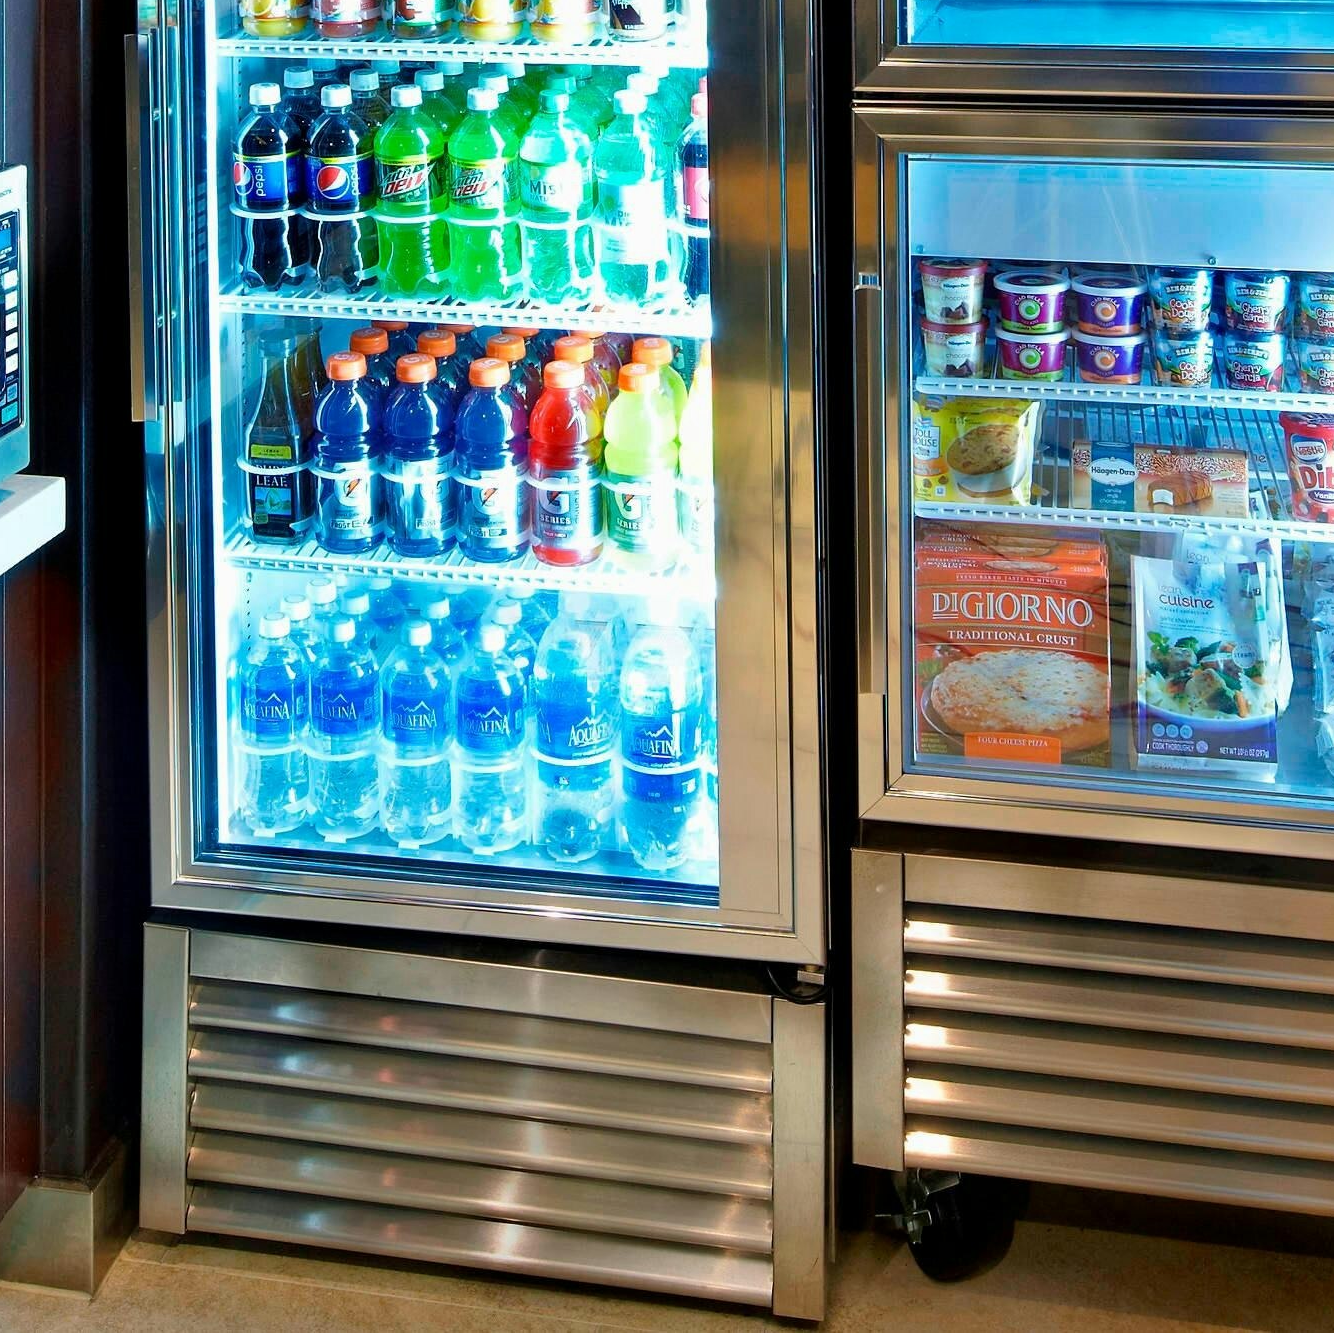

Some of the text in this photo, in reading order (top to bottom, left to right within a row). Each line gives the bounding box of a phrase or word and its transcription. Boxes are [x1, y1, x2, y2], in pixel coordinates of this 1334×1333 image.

[256, 165, 266, 197] pepsi
[1242, 302, 1272, 315] Cherry
[1243, 313, 1270, 323] Garcia
[1233, 362, 1262, 374] Cherry
[1235, 371, 1261, 382] Garcia
[914, 428, 932, 439] TOLL
[1091, 467, 1136, 476] Häagen-Dazs
[256, 475, 286, 487] LEAF
[540, 516, 571, 524] SERIES
[1159, 593, 1214, 609] cuisine
[947, 630, 1077, 646] TRADITIONAL CRUST
[978, 736, 1048, 747] FOUR CHEESE PIZZA
